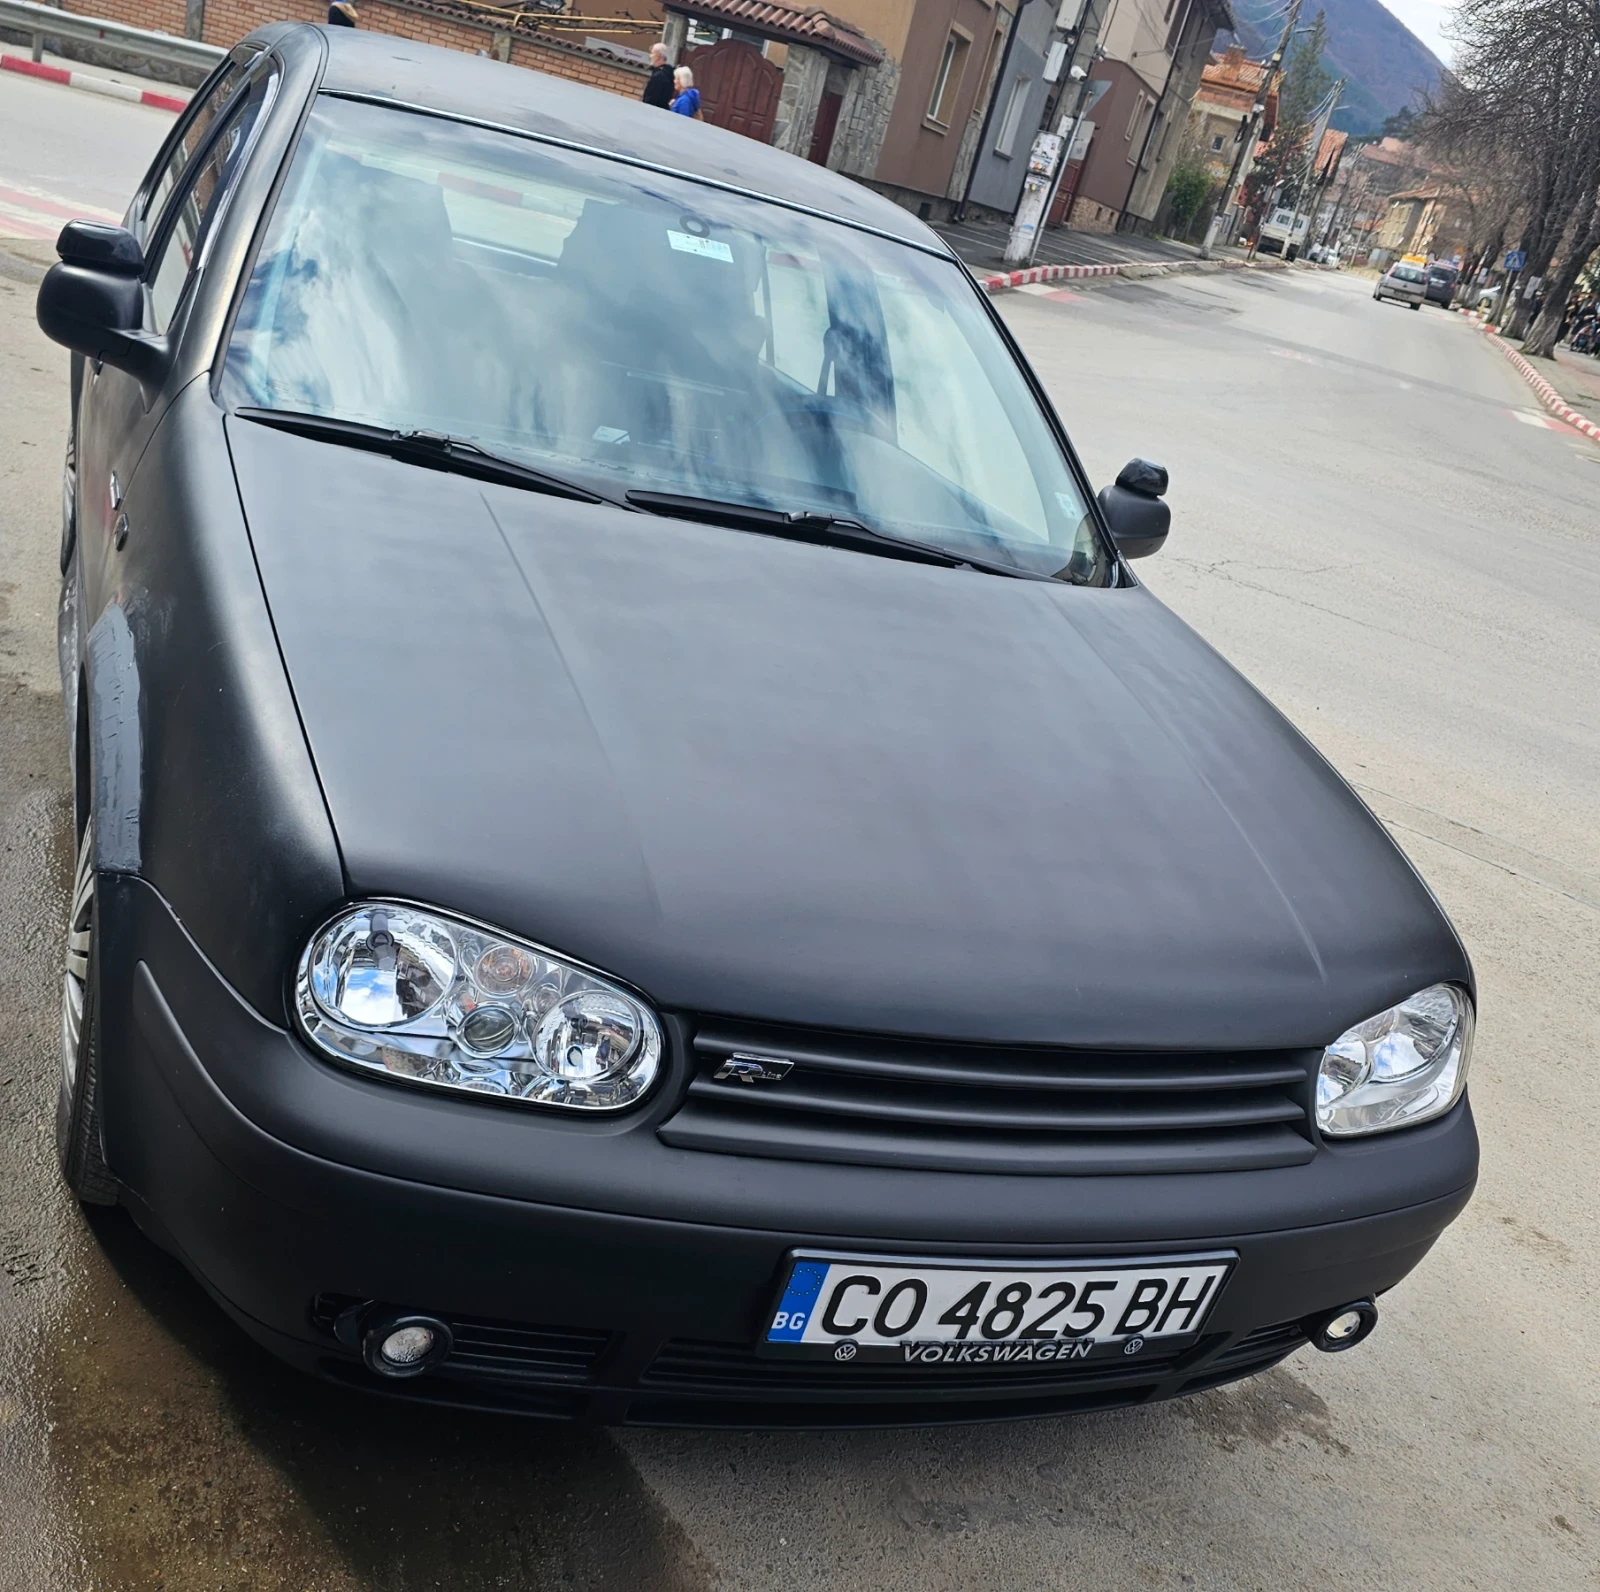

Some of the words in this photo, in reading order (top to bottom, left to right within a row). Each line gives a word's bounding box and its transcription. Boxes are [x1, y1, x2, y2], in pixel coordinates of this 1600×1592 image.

[821, 1275, 928, 1338] CO
[937, 1281, 1118, 1340] 4825
[1111, 1275, 1217, 1335] BH
[771, 1311, 806, 1331] BG
[902, 1340, 1096, 1363] VOLKSWAGEN
